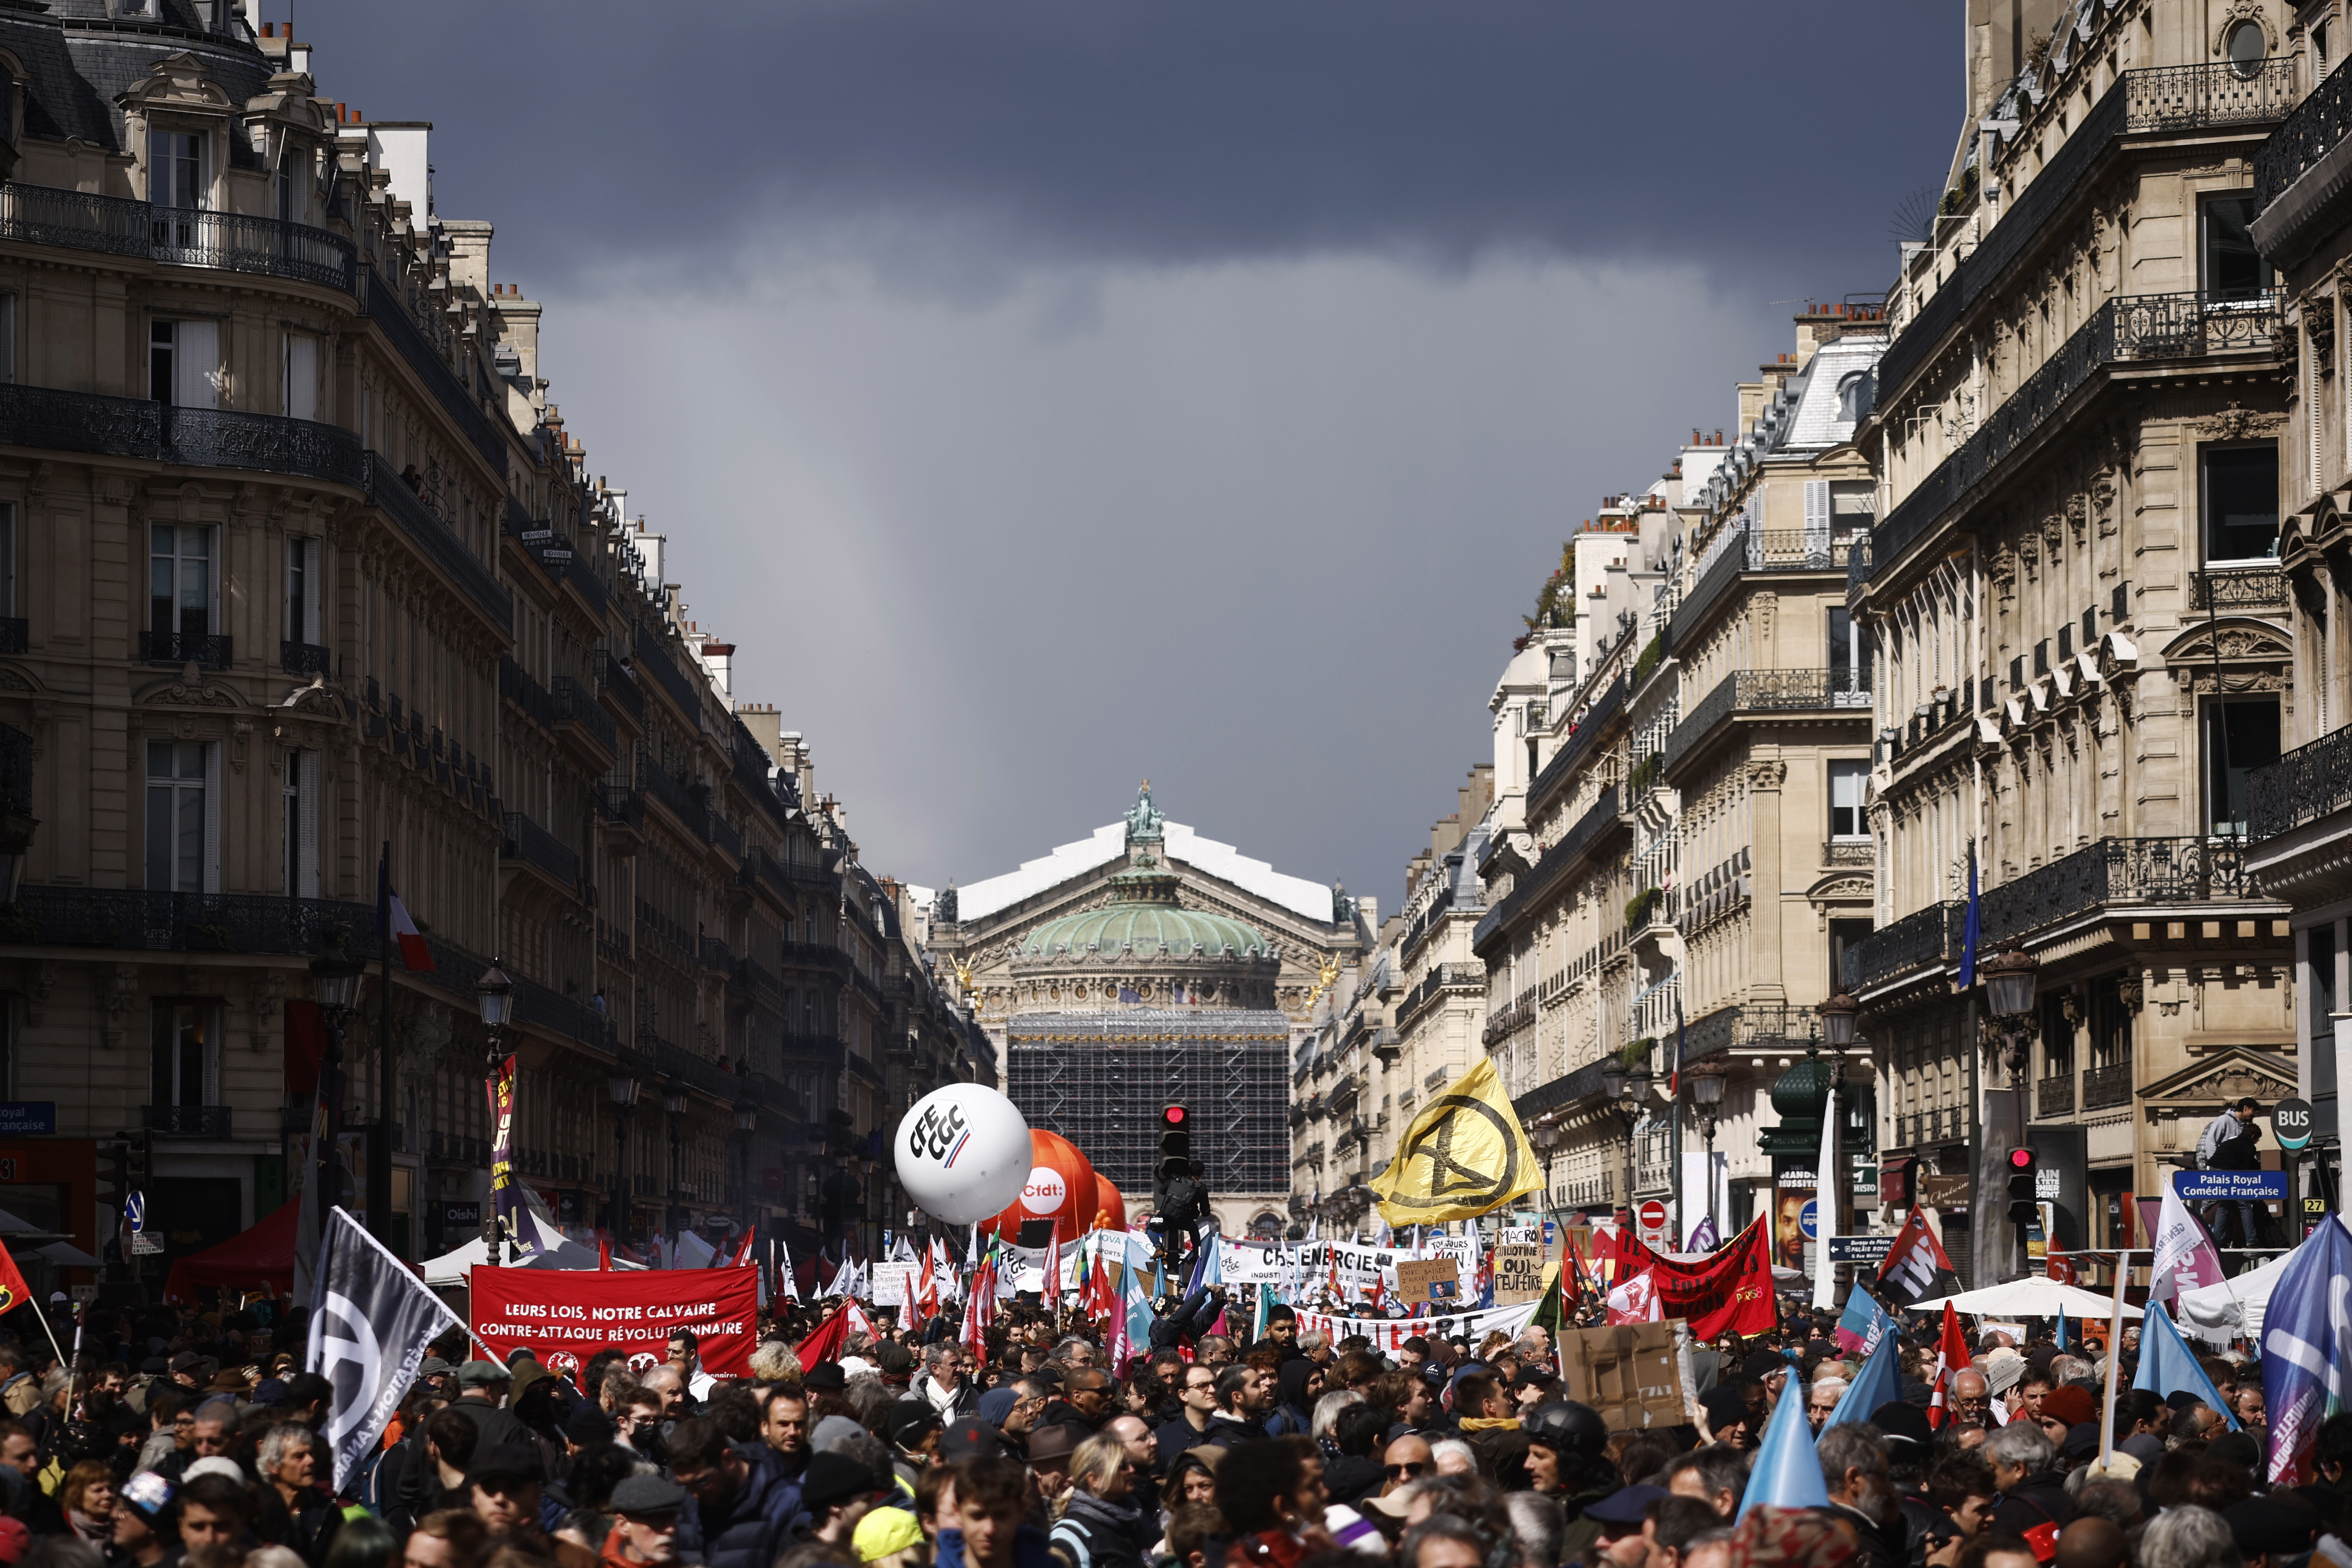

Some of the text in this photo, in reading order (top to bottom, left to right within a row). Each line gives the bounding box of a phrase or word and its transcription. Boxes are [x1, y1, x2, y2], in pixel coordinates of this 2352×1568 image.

[2278, 1111, 2309, 1126] BUS
[0, 1120, 45, 1132] rançaise
[910, 1103, 939, 1158] CFE
[928, 1104, 965, 1160] CGC
[1779, 1171, 1817, 1179] GRANDE
[2036, 1169, 2059, 1179] AIN
[2200, 1175, 2261, 1186] Palais Royal
[1778, 1179, 1817, 1188] RÉUSSITE
[1854, 1184, 1876, 1192] HISTO
[2183, 1186, 2279, 1197] Comédie Française
[2307, 1201, 2322, 1211] 27
[447, 1209, 477, 1220] Oishi
[1497, 1229, 1543, 1244] MACRON
[1623, 1233, 1640, 1257] IL
[1000, 1247, 1015, 1266] FE
[1221, 1256, 1233, 1267] CFE
[1011, 1256, 1026, 1274] GC
[1227, 1261, 1240, 1272] CGC
[1504, 1259, 1531, 1274] OUI
[1740, 1253, 1760, 1277] LA
[1402, 1276, 1427, 1284] J'AURAIS
[1671, 1275, 1713, 1294] FOIS
[1404, 1284, 1425, 1297] Robert
[506, 1303, 716, 1321] LEURS LOIS, NOTRE CALVAIRE
[480, 1323, 603, 1340] CONTRE-ATTAQUE
[1296, 1313, 1484, 1350] NANTERRE
[2176, 1328, 2192, 1336] MACRON
